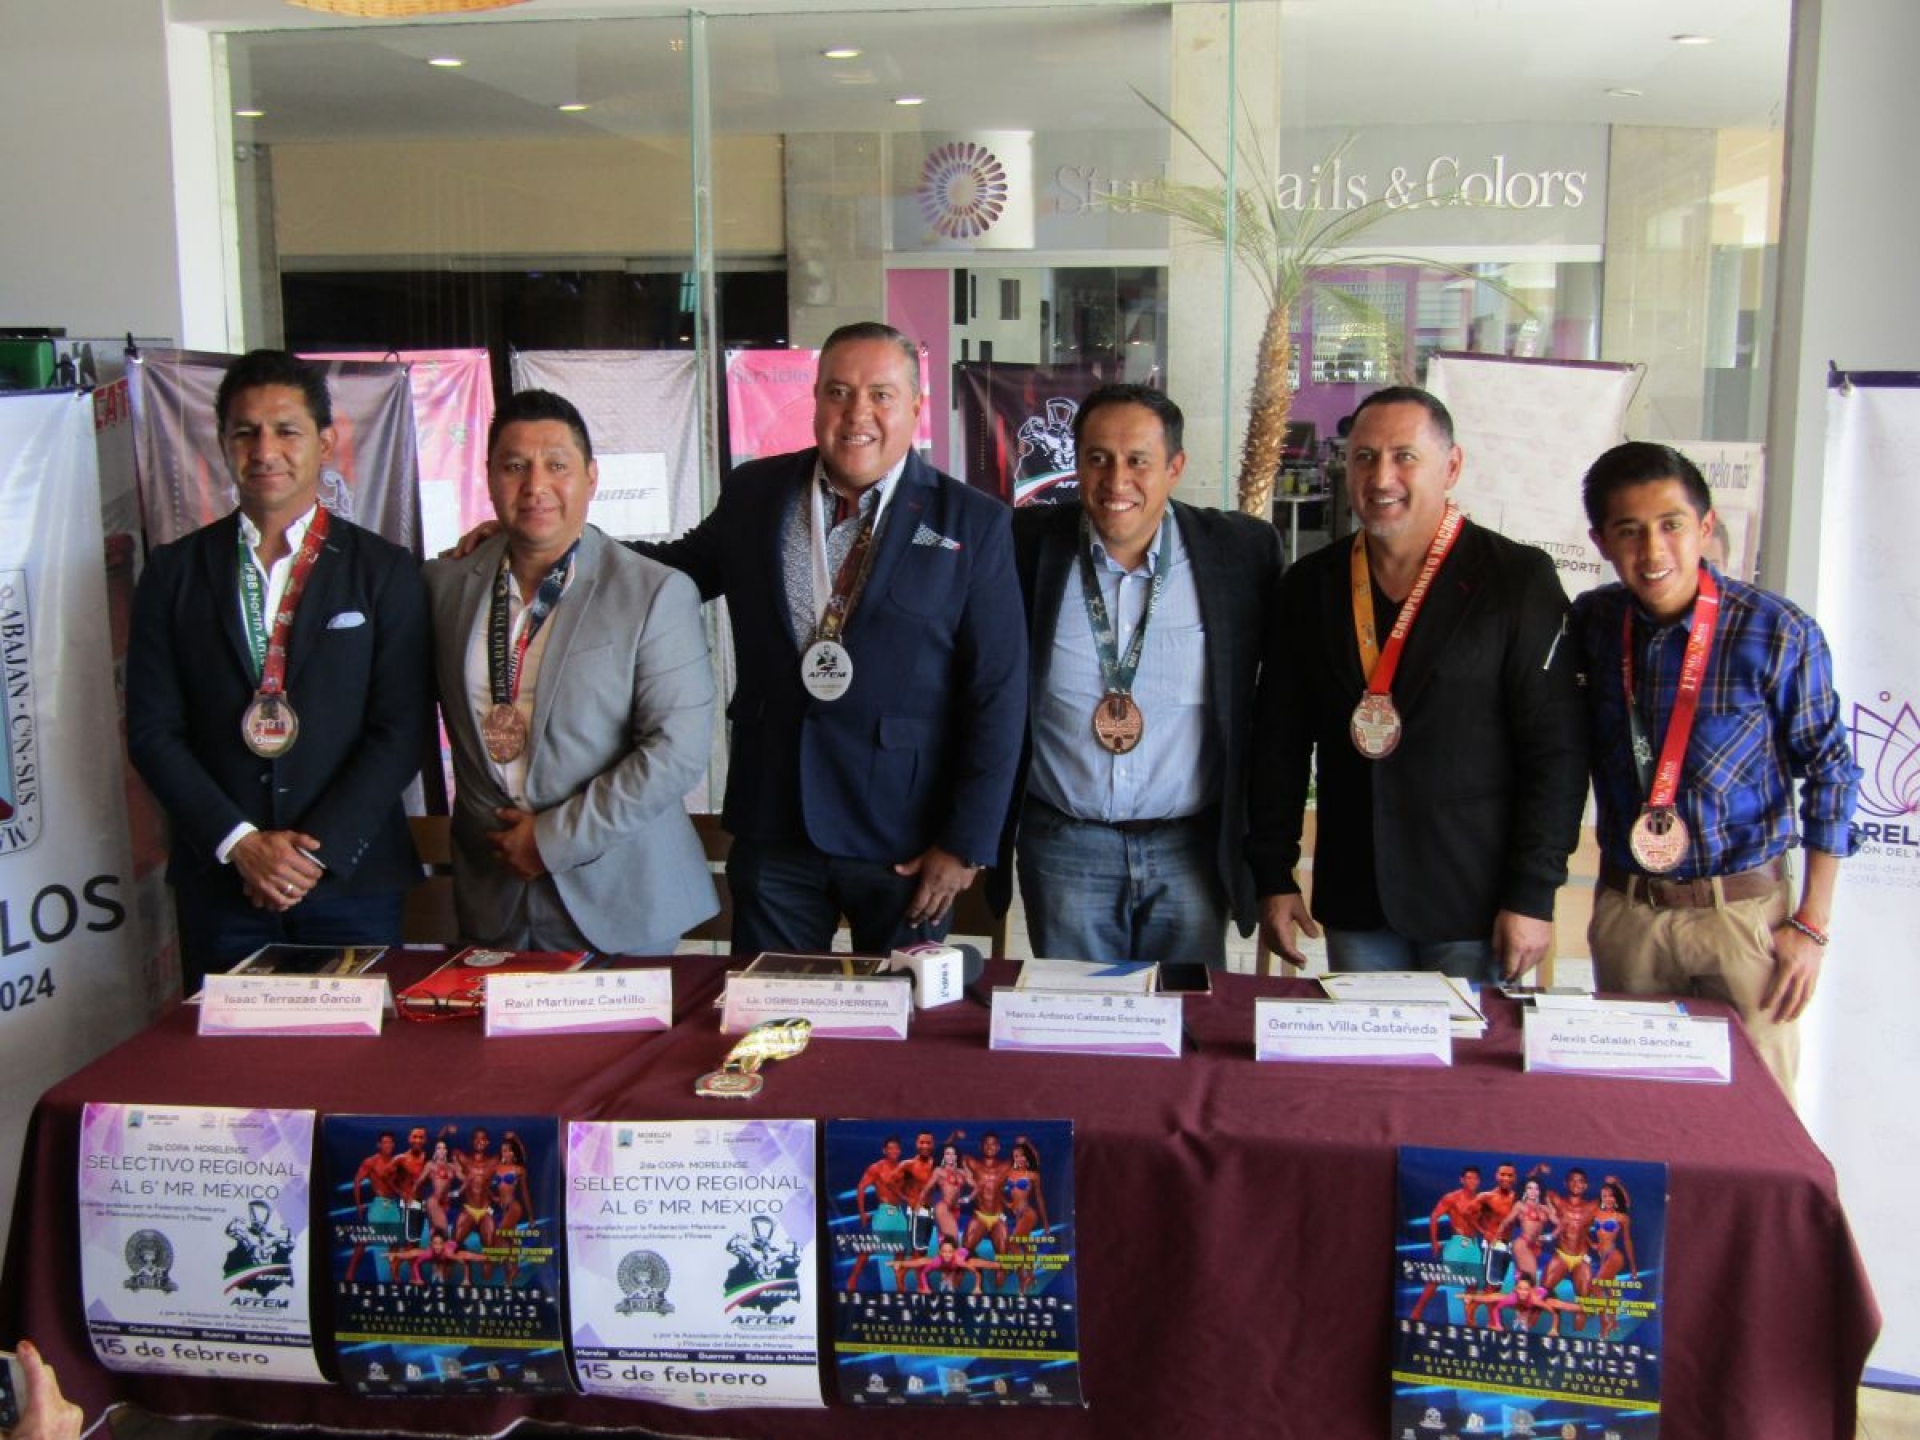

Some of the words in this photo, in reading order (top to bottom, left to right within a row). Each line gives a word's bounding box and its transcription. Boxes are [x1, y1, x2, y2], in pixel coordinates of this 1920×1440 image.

[1278, 154, 1368, 211] ails
[1385, 166, 1420, 209] &
[1426, 155, 1587, 210] Colors
[1391, 557, 1440, 639] CAMPEONATO
[262, 993, 317, 1004] Terrazas
[597, 994, 646, 1006] Castillo
[1268, 1018, 1324, 1032] Germán
[1327, 1020, 1358, 1033] Villa
[1361, 1020, 1439, 1036] Castañeda
[1550, 1032, 1587, 1045] Alexis
[86, 1155, 194, 1172] SELECTIVO
[200, 1159, 301, 1177] REGIONAL
[689, 1160, 750, 1169] MORELENSE
[109, 1181, 135, 1195] AL
[203, 1180, 279, 1200] MÉXICO
[573, 1176, 690, 1191] SELECTIVO
[696, 1176, 806, 1191] REGIONAL
[600, 1200, 627, 1214] AL
[701, 1196, 784, 1214] MÉXICO
[229, 1297, 289, 1309] AFFEM
[730, 1315, 796, 1325] AFFEM
[852, 1322, 965, 1336] PRINCIPIANTES
[990, 1328, 1058, 1339] NOVATOS
[865, 1331, 945, 1344] ESTRELLAS
[954, 1336, 979, 1346] DEL
[988, 1337, 1045, 1348] FUTURO
[93, 1337, 126, 1356] 15
[135, 1341, 165, 1357] de
[171, 1343, 269, 1365] febrero
[579, 1362, 612, 1380] 15
[622, 1364, 654, 1381] de
[664, 1366, 767, 1386] febrero
[1412, 1353, 1538, 1378] PRINCIPIANTES
[1563, 1370, 1640, 1389] NOVATOS
[1425, 1364, 1514, 1385] ESTRELLAS
[1522, 1376, 1551, 1389] DEL
[1560, 1380, 1625, 1397] FUTURO
